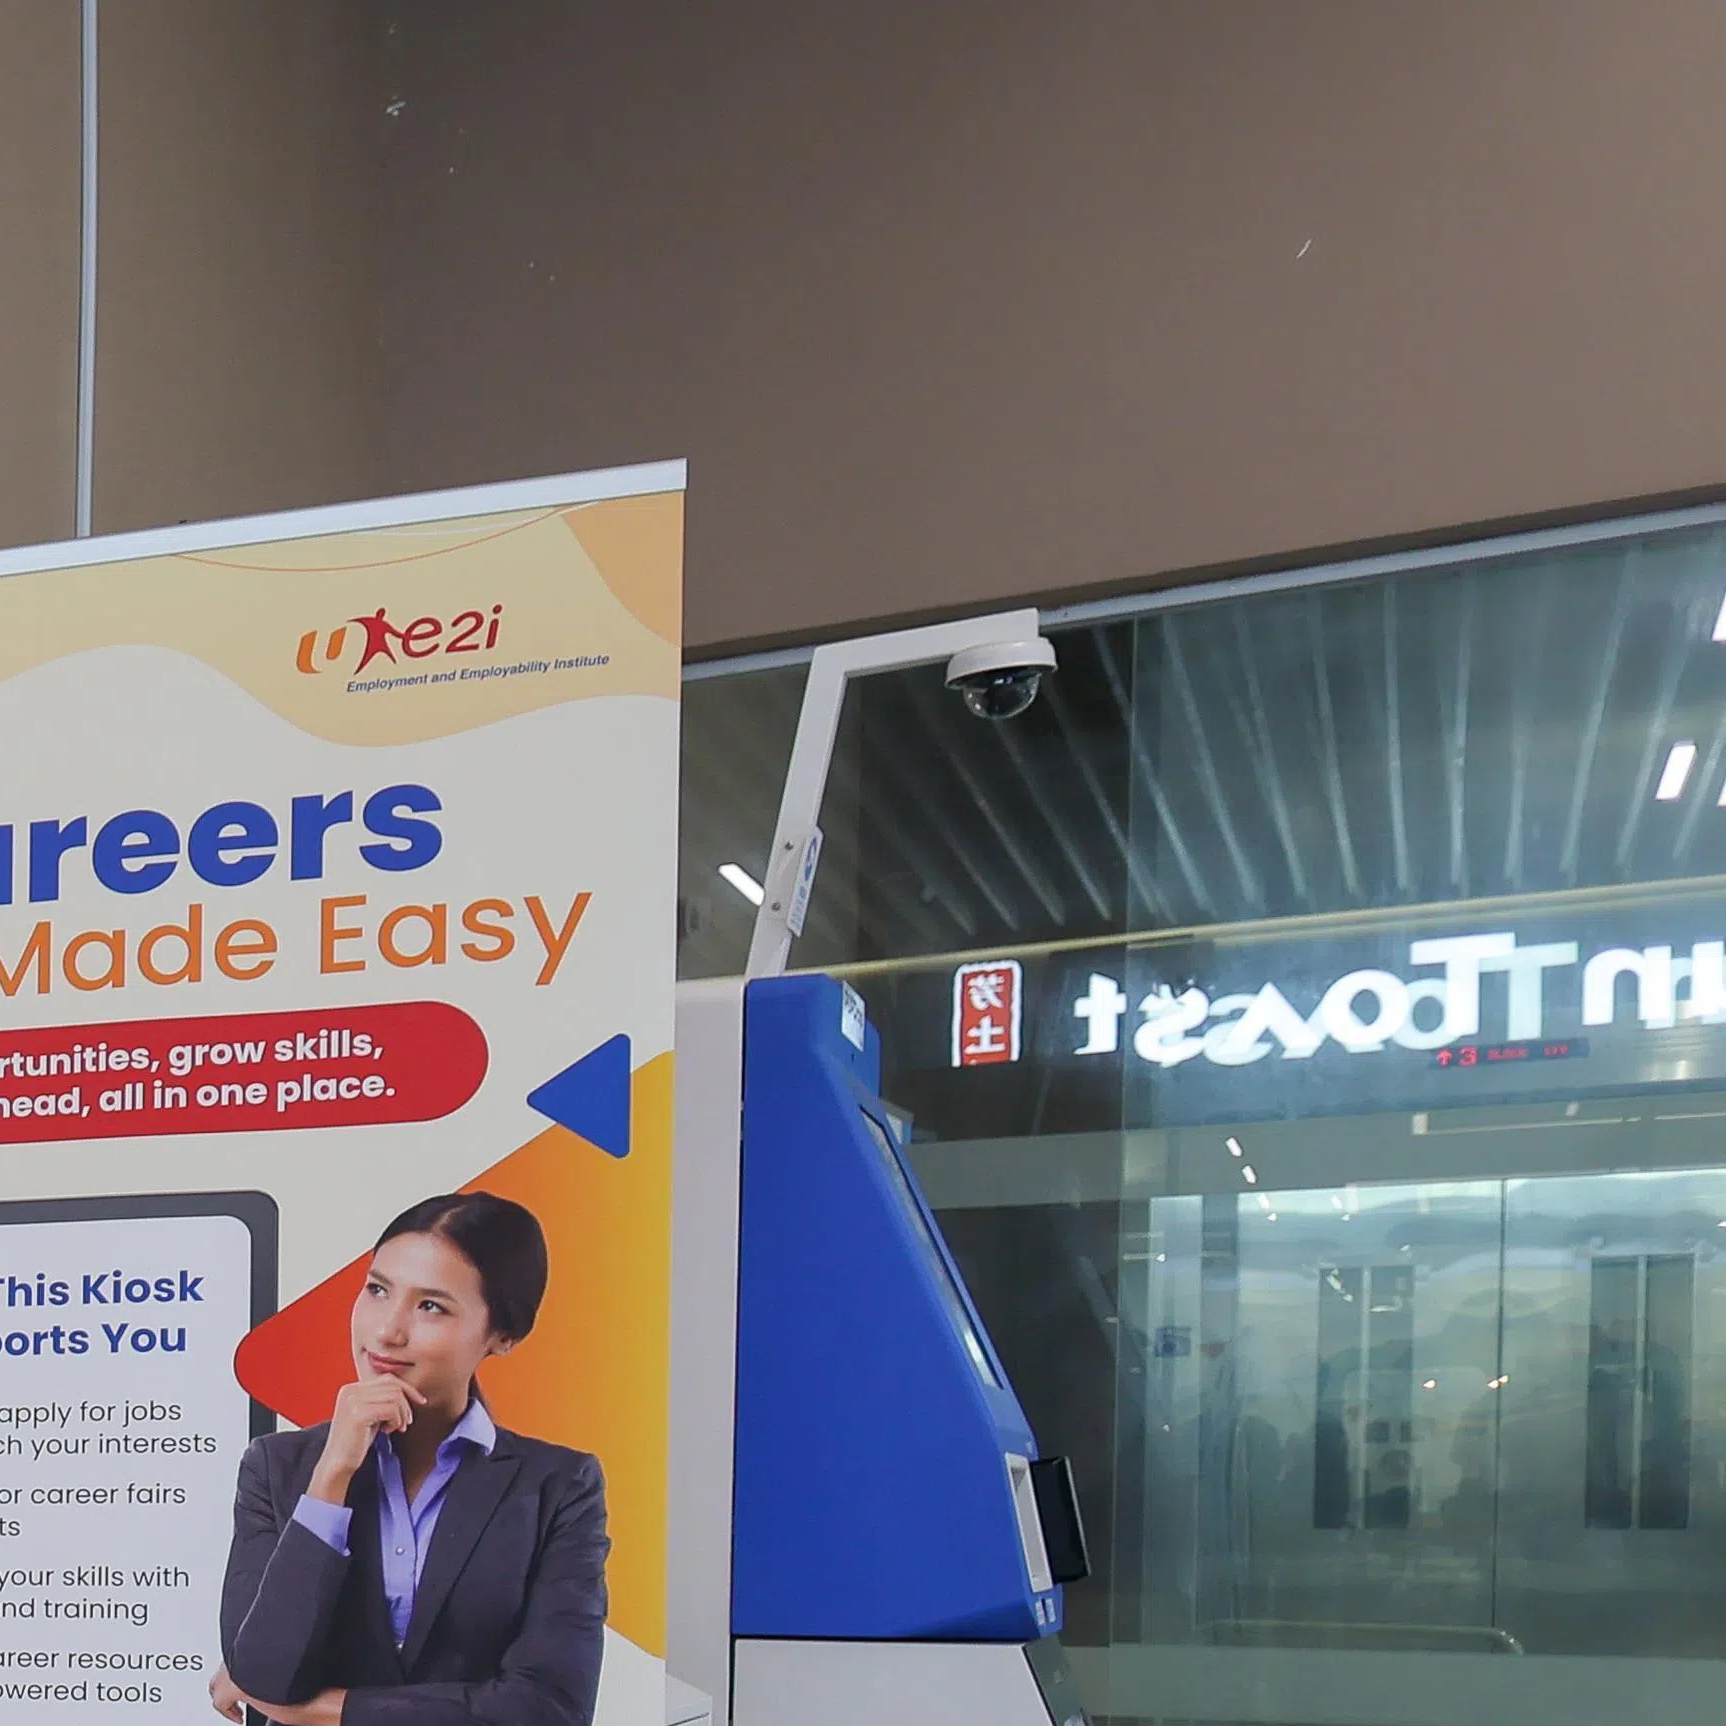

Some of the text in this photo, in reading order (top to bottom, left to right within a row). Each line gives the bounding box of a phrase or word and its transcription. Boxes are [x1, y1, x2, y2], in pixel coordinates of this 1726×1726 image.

[347, 656, 609, 692] Employment and Employability Institute
[320, 892, 592, 986] Easy
[169, 1041, 267, 1076] grow
[275, 1029, 384, 1061] skills,
[100, 1083, 145, 1111] all
[154, 1080, 188, 1108] in
[197, 1083, 268, 1106] one
[277, 1074, 396, 1112] place.
[83, 1270, 203, 1304] Kiosk
[102, 1323, 185, 1353] You
[80, 1401, 116, 1421] for
[123, 1400, 181, 1427] jobs
[31, 1439, 90, 1460] your
[100, 1433, 216, 1453] interests
[31, 1489, 118, 1504] career
[127, 1483, 185, 1503] fairs
[63, 1566, 123, 1586] skills
[133, 1566, 188, 1587] with
[44, 1598, 147, 1626] training
[69, 1653, 202, 1670] resources
[113, 1683, 161, 1702] tools
